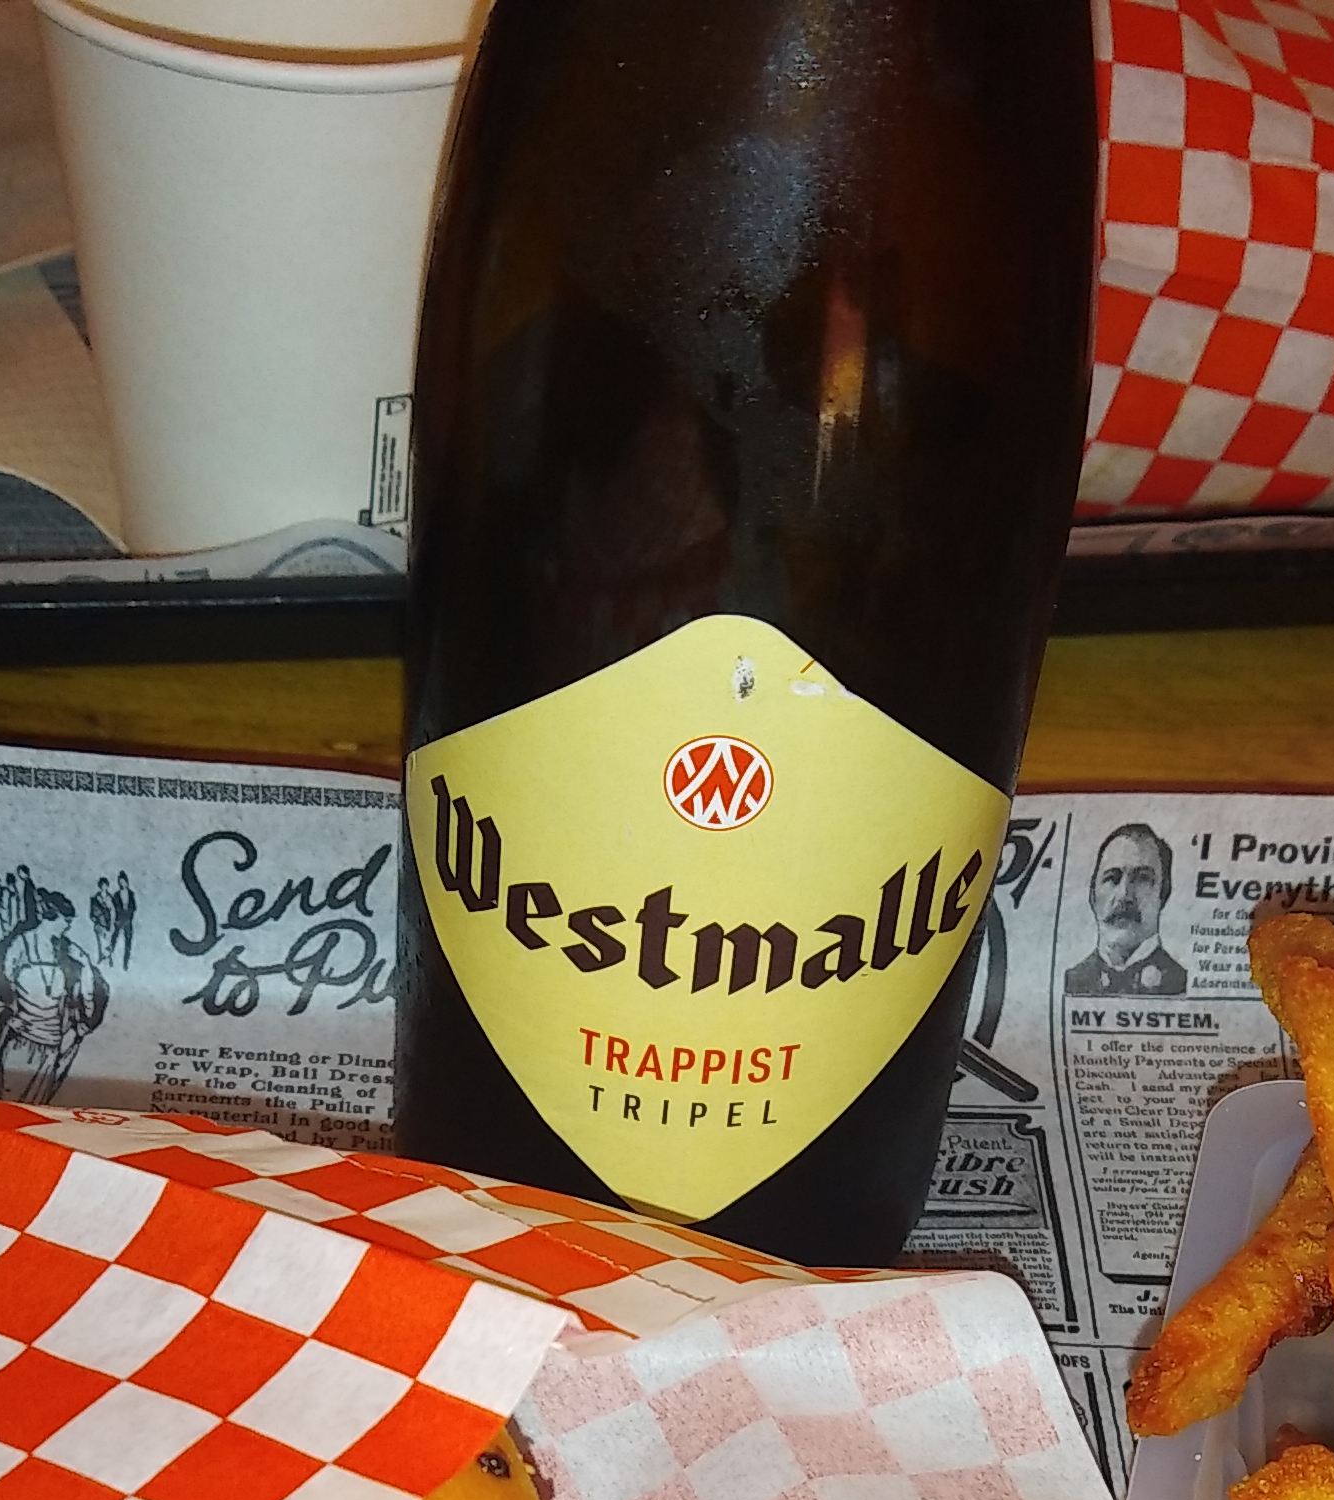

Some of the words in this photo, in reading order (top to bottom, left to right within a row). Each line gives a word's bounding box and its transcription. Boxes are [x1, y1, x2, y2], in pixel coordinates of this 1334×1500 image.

[430, 775, 983, 995] Westmalle
[169, 830, 393, 957] Send
[1212, 907, 1231, 920] for
[1192, 941, 1210, 954] for
[182, 945, 264, 1016] to
[283, 918, 396, 1017] Pu
[1199, 960, 1231, 972] Wear
[1072, 1011, 1106, 1027] MY
[1116, 1011, 1220, 1029] SYSTEM.
[158, 1042, 209, 1058] Your
[218, 1046, 301, 1066] Evening
[308, 1054, 331, 1065] or
[1101, 1041, 1134, 1053] offer
[1141, 1042, 1164, 1052] the
[1170, 1044, 1256, 1055] convenience
[1263, 1043, 1276, 1054] of
[579, 1028, 801, 1085] TRAPPIST
[1073, 1055, 1131, 1068] Monthly
[1135, 1056, 1205, 1069] Payments
[1209, 1059, 1224, 1068] or
[1227, 1058, 1278, 1069] Special
[154, 1061, 180, 1071] or
[192, 1061, 260, 1078] Wrap.
[271, 1065, 318, 1079] Ball
[1074, 1069, 1137, 1080] Discount
[1157, 1070, 1240, 1081] Advantages
[153, 1073, 191, 1087] For
[204, 1078, 237, 1090] the
[250, 1079, 342, 1099] Cleaning
[356, 1087, 376, 1099] of
[1075, 1081, 1115, 1092] Cash.
[1142, 1083, 1175, 1092] send
[1179, 1085, 1202, 1095] my
[151, 1090, 252, 1106] garments
[264, 1097, 297, 1110] the
[310, 1098, 376, 1114] Pullar
[588, 1085, 777, 1128] TRIPEL
[1076, 1094, 1103, 1105] ject
[1117, 1095, 1132, 1104] to
[1143, 1096, 1176, 1106] your
[1079, 1105, 1122, 1115] Seven
[1124, 1106, 1164, 1116] Clear
[190, 1107, 278, 1125] material
[290, 1112, 310, 1126] in
[320, 1117, 370, 1132] good
[1081, 1117, 1094, 1126] of
[1120, 1117, 1161, 1127] Small
[311, 1132, 338, 1147] by
[1083, 1130, 1107, 1139] are
[1113, 1130, 1138, 1139] not
[1085, 1142, 1131, 1151] return
[1134, 1142, 1149, 1151] to
[1152, 1143, 1178, 1152] me,
[937, 1151, 1025, 1173] ibre
[1088, 1152, 1115, 1162] will
[1119, 1152, 1136, 1162] be
[931, 1174, 1015, 1196] ush
[965, 1232, 983, 1241] the
[985, 1232, 1014, 1241] tooth
[1132, 1251, 1170, 1260] Agents
[1109, 1304, 1135, 1314] The
